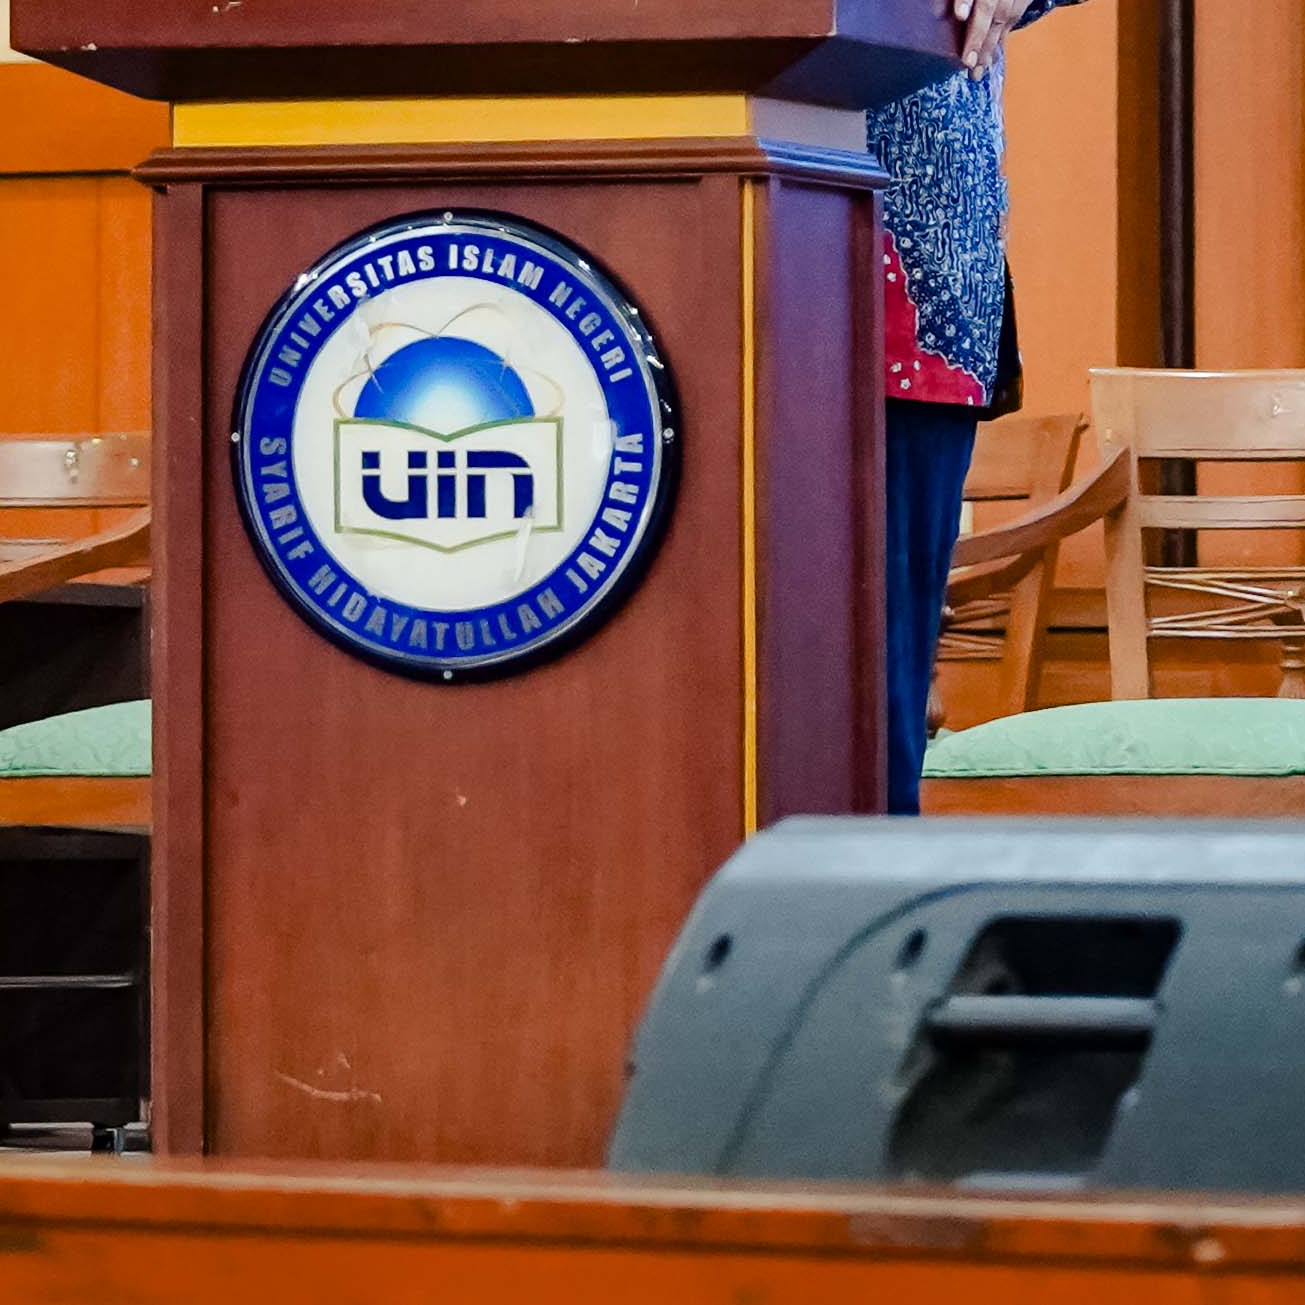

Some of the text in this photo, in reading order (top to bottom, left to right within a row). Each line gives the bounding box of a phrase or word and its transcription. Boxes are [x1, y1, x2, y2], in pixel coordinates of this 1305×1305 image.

[268, 243, 635, 388] UNIVERSITAS ISLAM NEGERI
[259, 432, 645, 652] SYARIF HIDAYATULLAH JAKARTA
